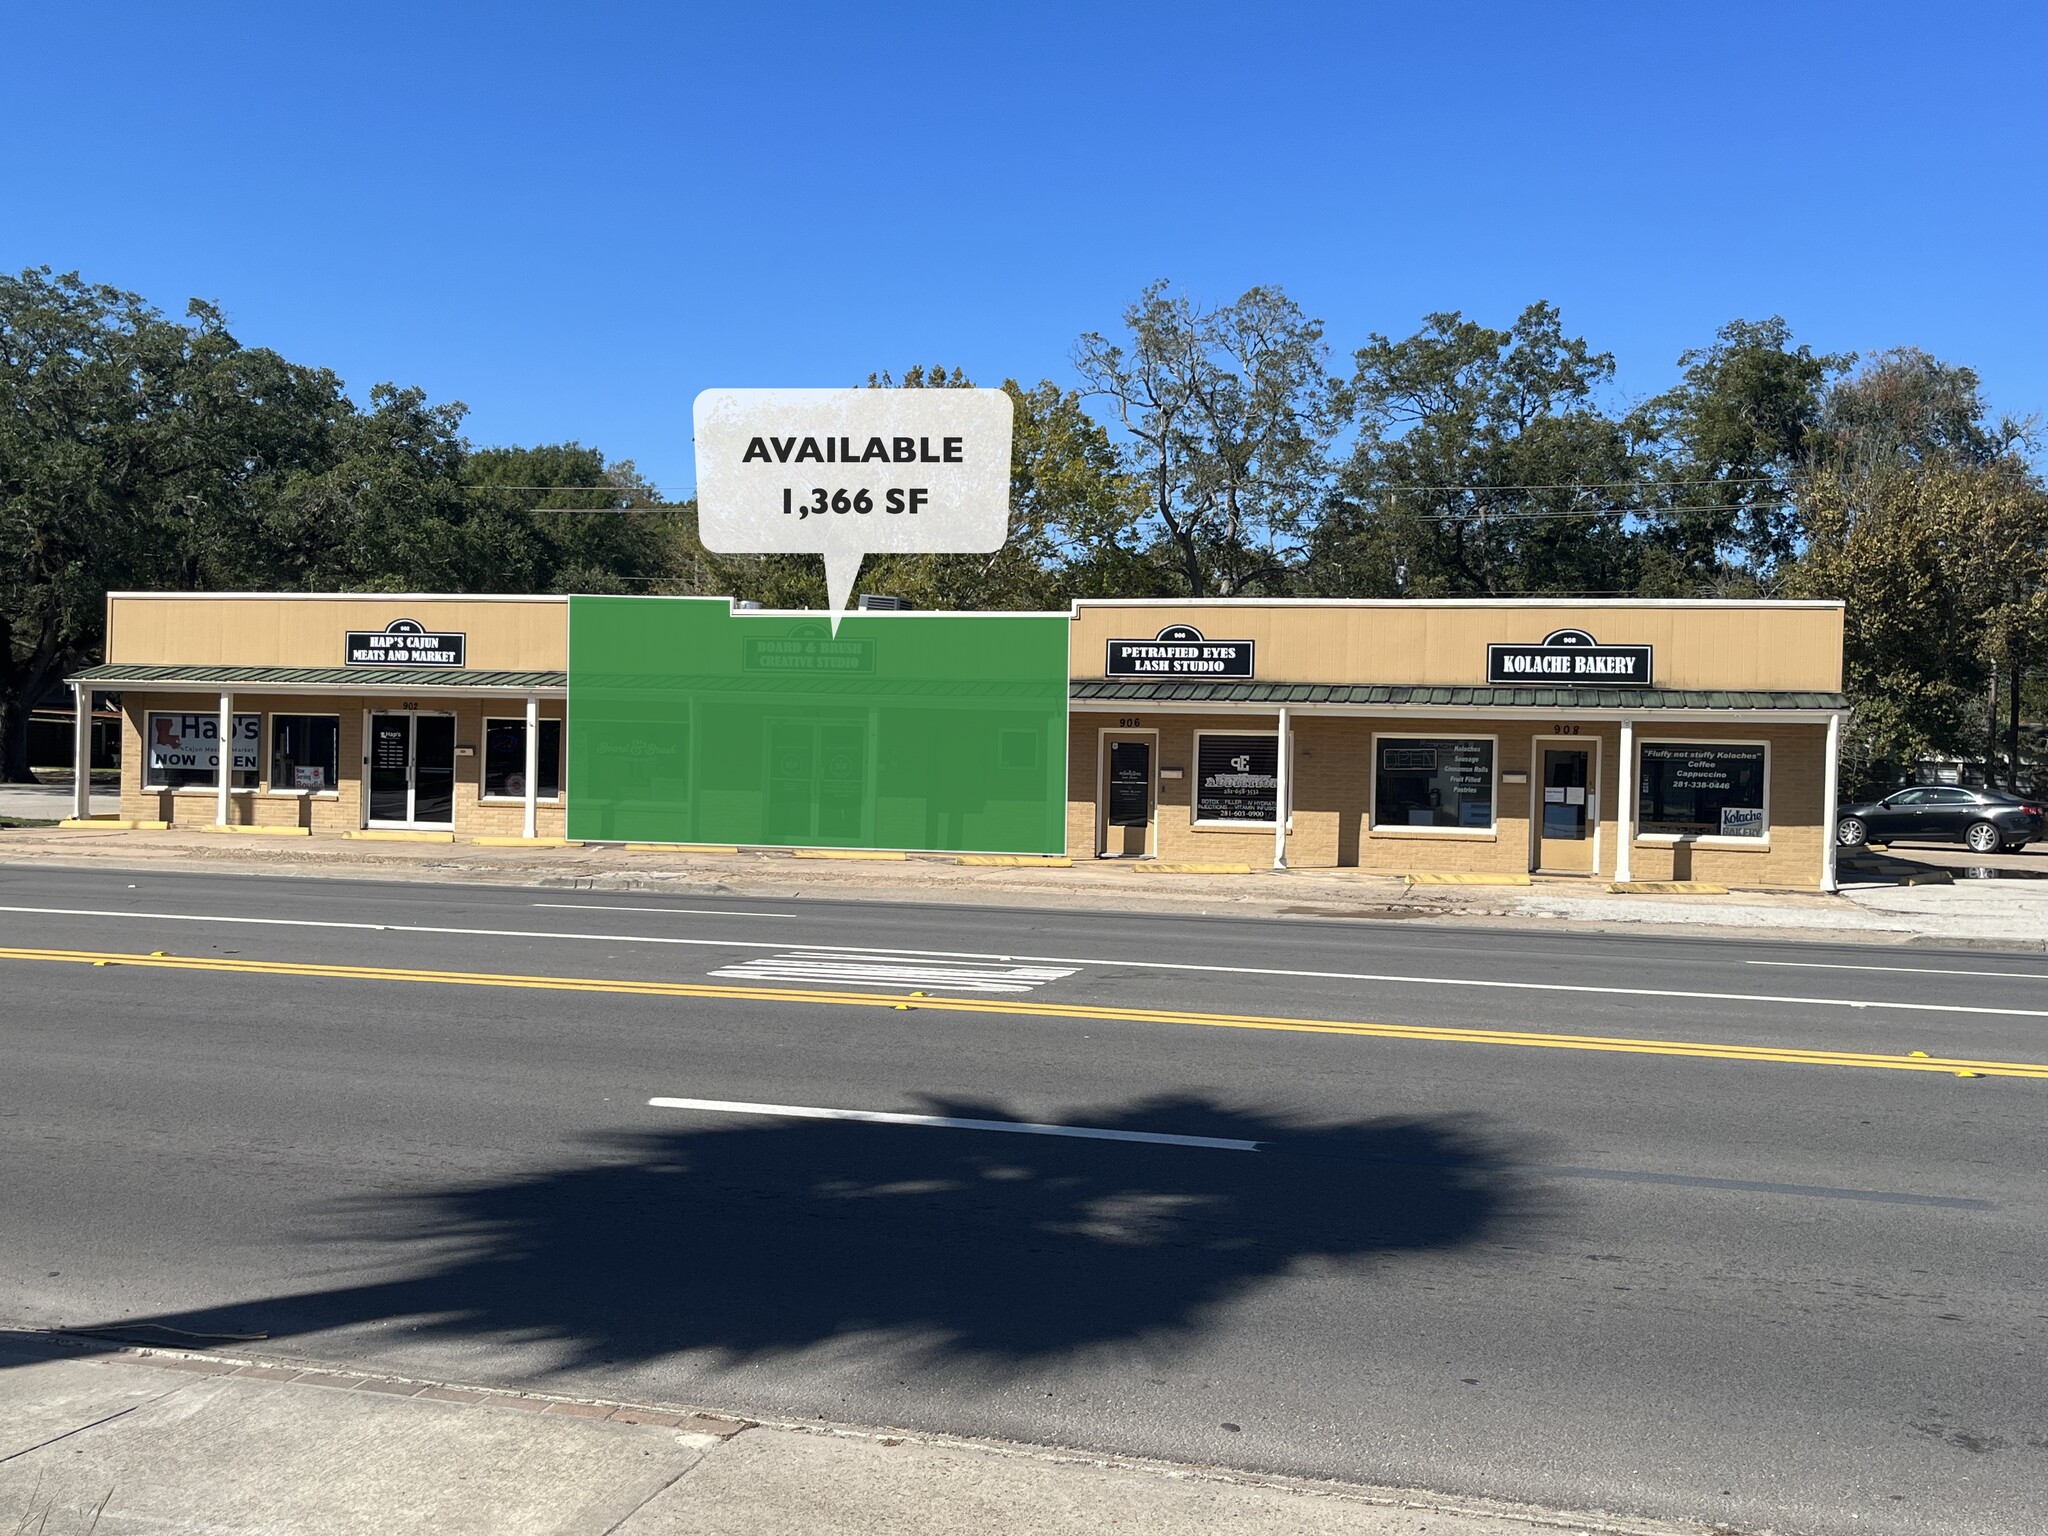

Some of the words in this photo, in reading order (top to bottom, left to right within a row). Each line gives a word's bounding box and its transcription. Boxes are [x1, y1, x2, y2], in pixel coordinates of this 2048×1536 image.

[369, 636, 405, 648] HAP'S
[406, 637, 440, 650] CAJUN
[757, 640, 801, 654] BOARD
[805, 641, 817, 654] &
[820, 642, 862, 655] BRUSH
[353, 649, 386, 661] MEATS
[387, 650, 409, 661] AND
[411, 651, 456, 663] MARKET
[1121, 646, 1199, 659] PETRAFIED
[1202, 647, 1236, 659] EYES
[759, 655, 814, 668] CREATIVE
[816, 656, 860, 669] STUDIO
[1134, 660, 1169, 672] LASH
[1173, 660, 1225, 672] STUDIO
[1502, 654, 1571, 674] KOLACHE
[1574, 655, 1637, 675] BAKERY
[403, 701, 419, 711] 902
[181, 715, 259, 740] Ha's
[1120, 717, 1141, 728] 906
[1554, 724, 1580, 735] 908
[155, 753, 197, 767] NOW
[208, 755, 257, 768] OEN
[1687, 760, 1716, 768] Coffee
[1676, 769, 1728, 779] Cappuccino
[1672, 780, 1731, 790] 281-338-0446
[1723, 809, 1763, 825] Kolache
